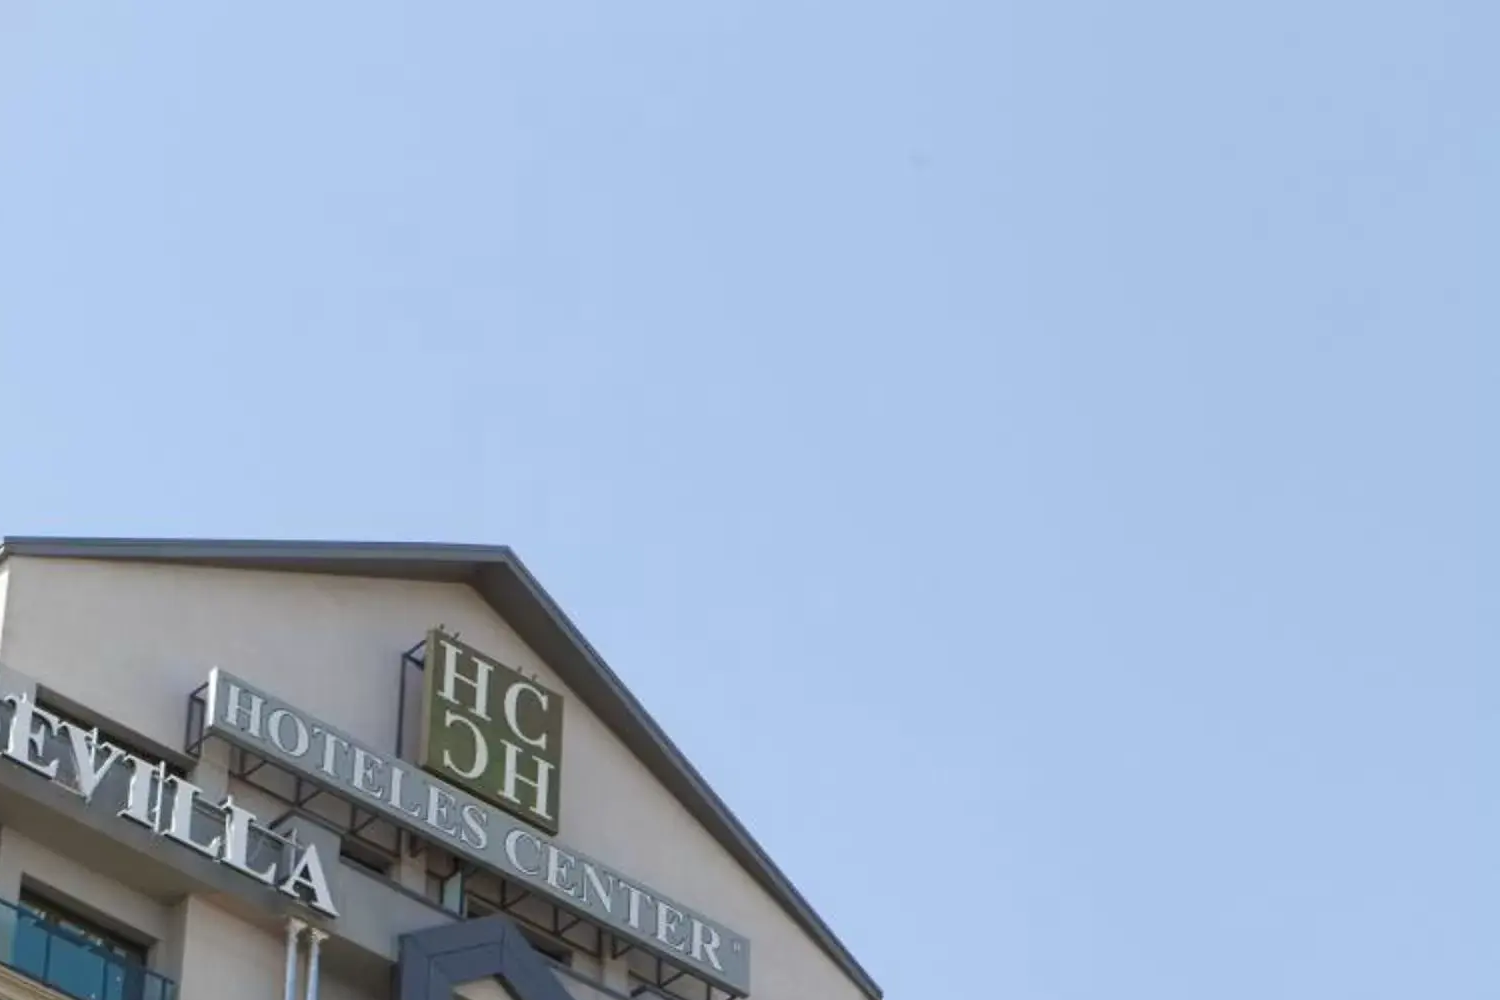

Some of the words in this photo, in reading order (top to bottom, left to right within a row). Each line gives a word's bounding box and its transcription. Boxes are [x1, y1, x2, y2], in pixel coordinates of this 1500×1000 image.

[436, 639, 549, 750] HC
[223, 683, 488, 850] HOTELES
[504, 827, 724, 971] CENTER
